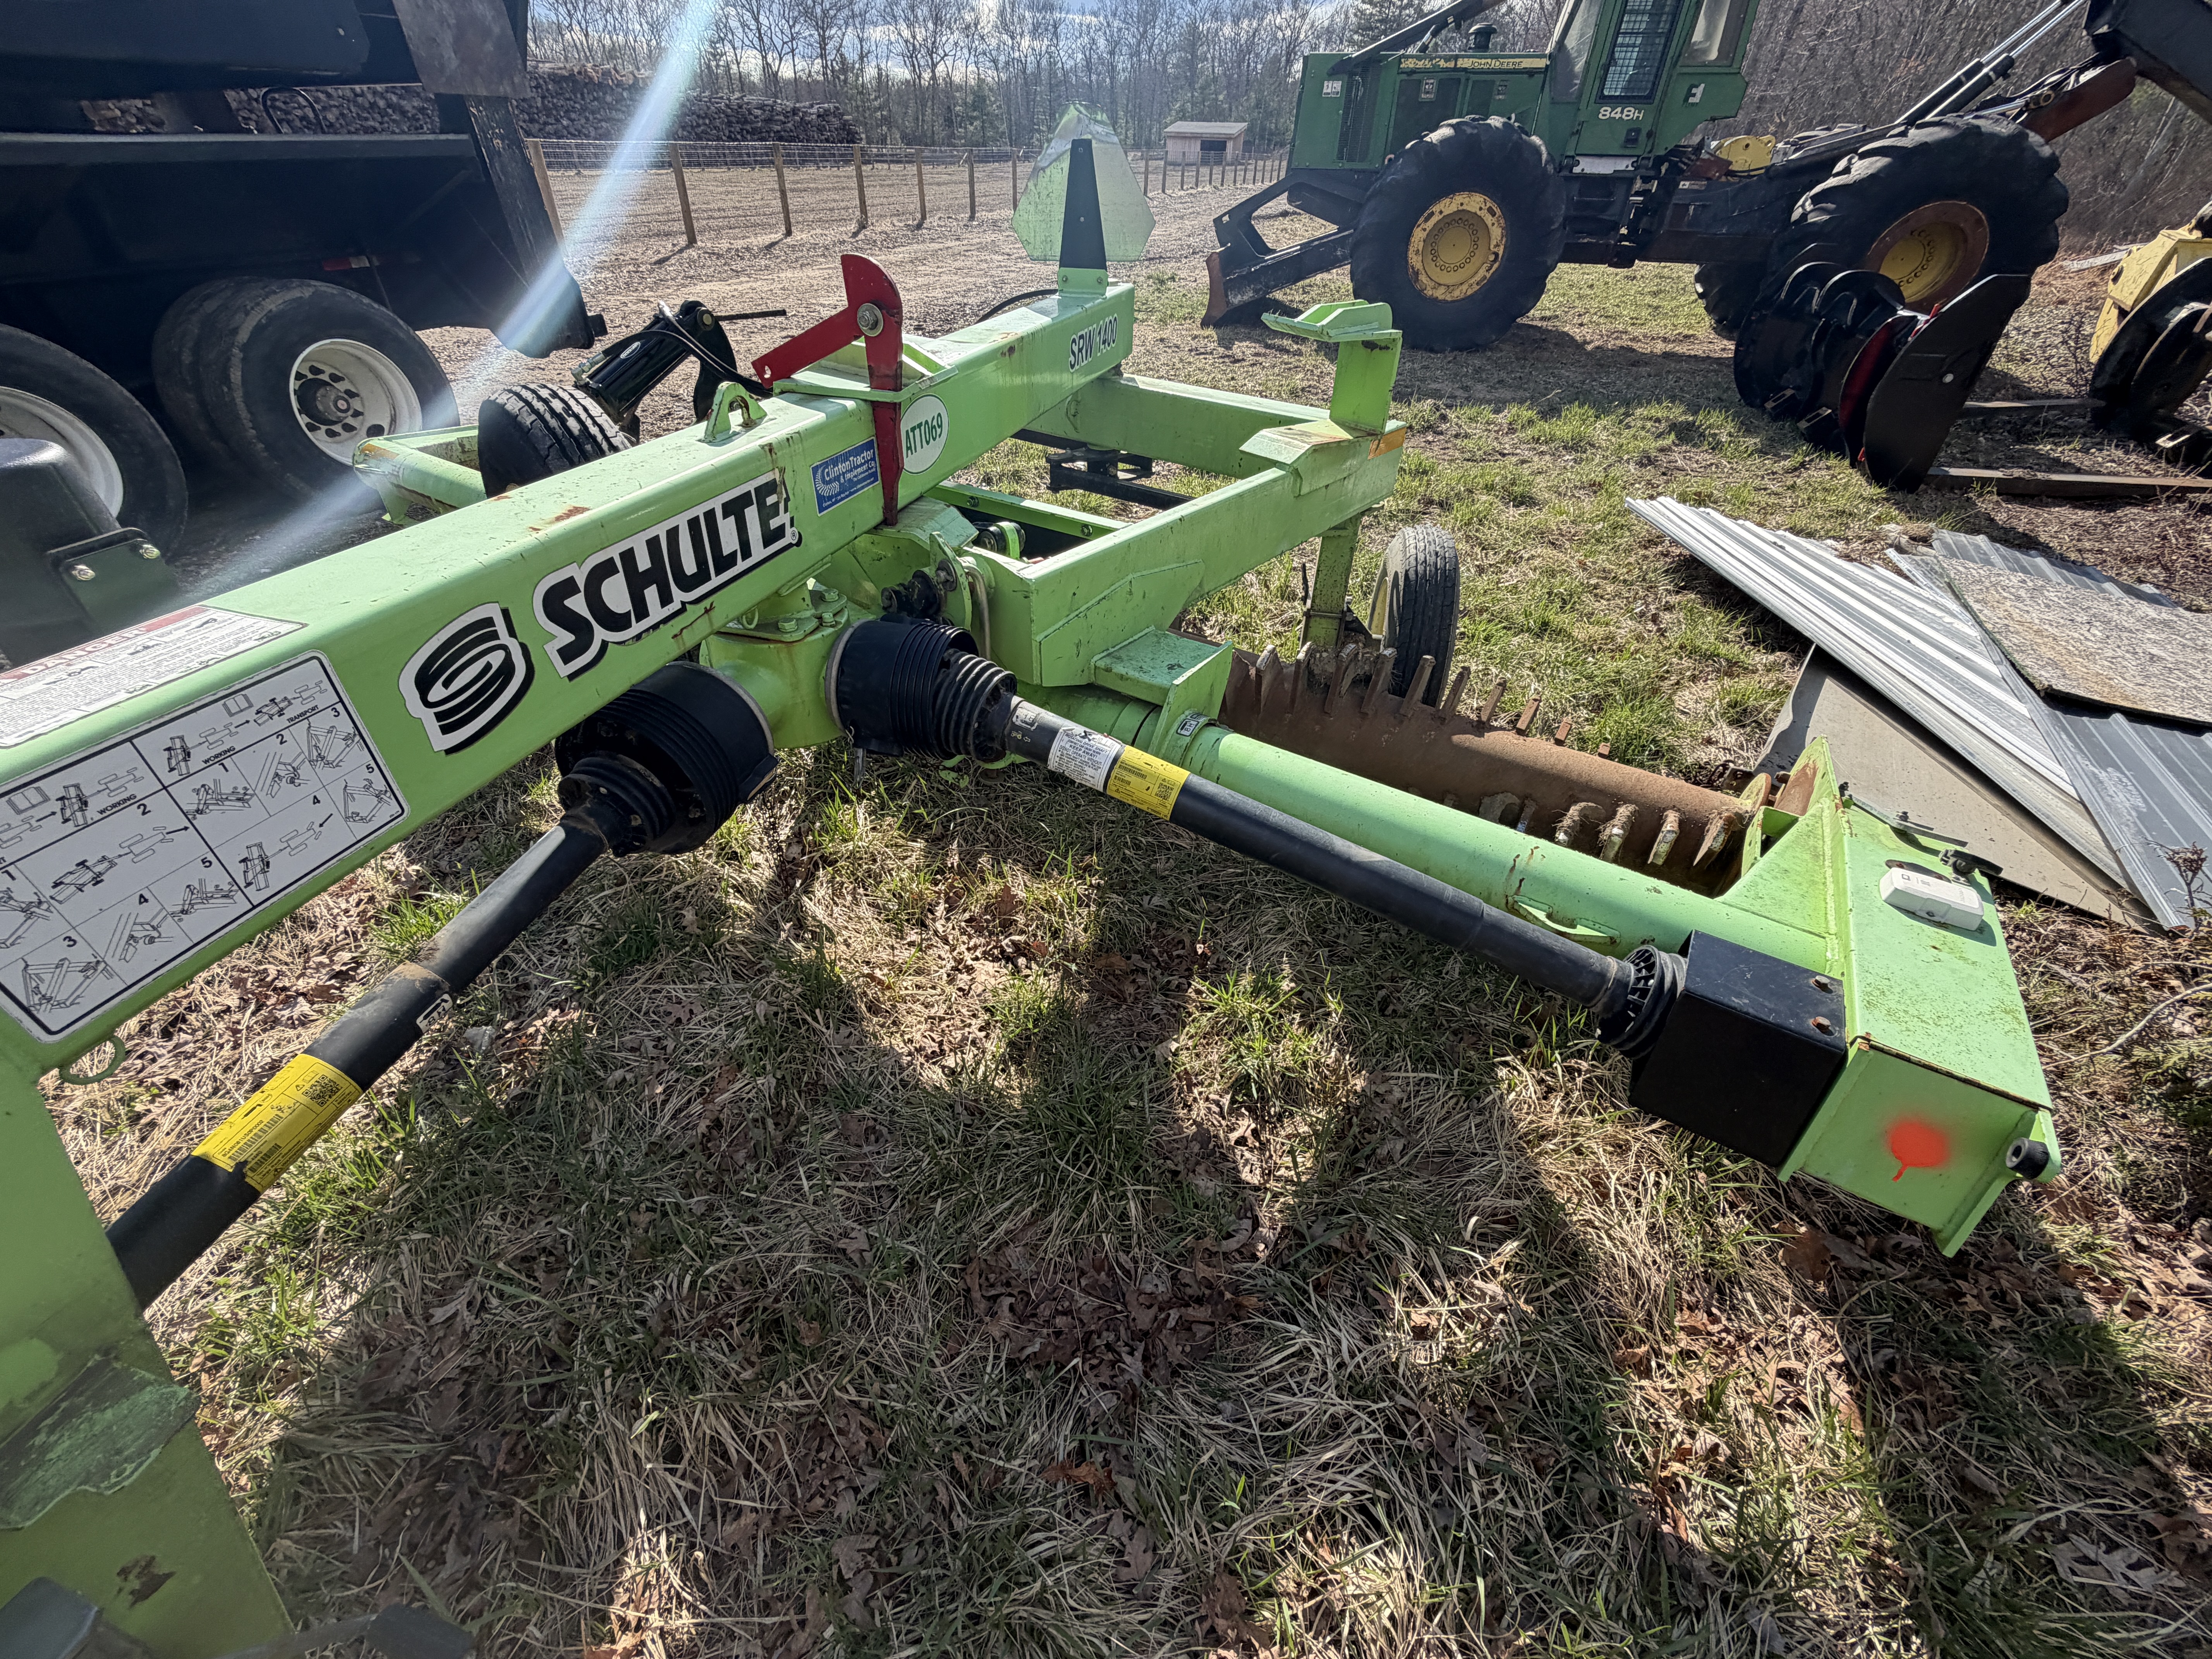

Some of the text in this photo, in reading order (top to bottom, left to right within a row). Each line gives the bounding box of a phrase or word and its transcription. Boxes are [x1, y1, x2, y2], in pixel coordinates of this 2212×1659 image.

[1468, 59, 1492, 67] JOHN
[1599, 106, 1644, 120] 848H
[1070, 316, 1117, 370] SRW 1400
[905, 412, 943, 458] ATT069
[845, 463, 868, 480] Implement
[541, 479, 786, 666] SCHULTE
[21, 627, 149, 675] DANGER
[287, 704, 319, 723] TRANSPORT
[330, 707, 340, 718] 3
[276, 733, 287, 745] 2
[202, 746, 236, 765] WORKING
[1069, 744, 1097, 759] KEEP AWAY!
[1071, 750, 1087, 759] OPERATE
[218, 762, 229, 772] 1
[366, 764, 375, 774] 5
[96, 793, 137, 816] WORKING
[312, 795, 321, 805] 4
[137, 803, 151, 816] 2
[201, 857, 213, 868] 5
[1, 870, 16, 881] 1
[138, 893, 149, 905] 4
[63, 936, 77, 947] 3
